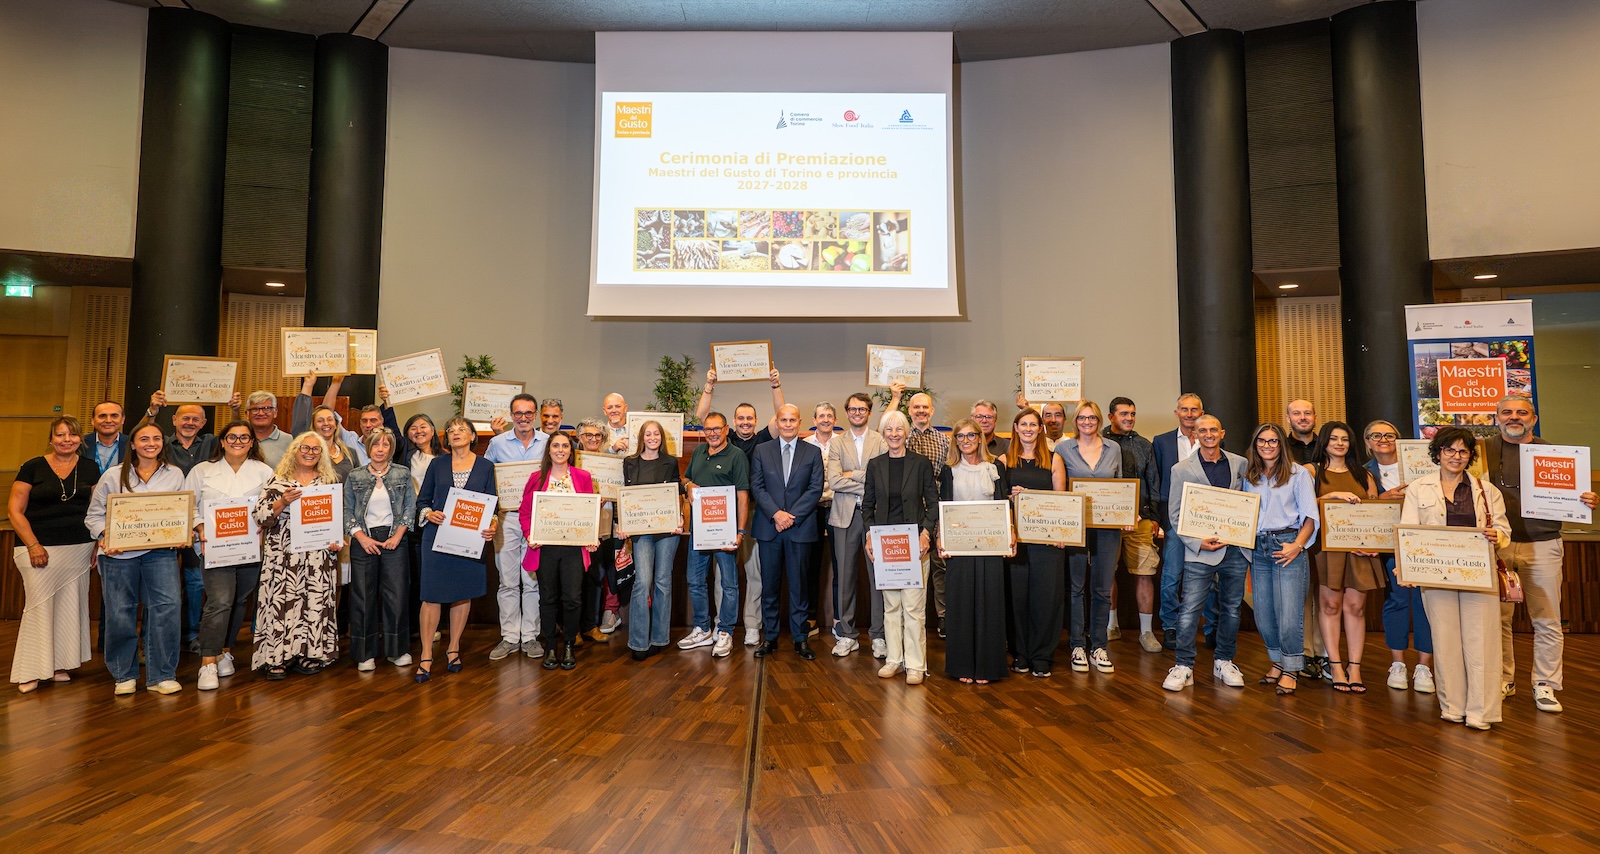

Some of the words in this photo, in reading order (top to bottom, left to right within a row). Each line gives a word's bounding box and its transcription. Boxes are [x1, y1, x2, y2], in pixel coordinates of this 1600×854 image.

[617, 104, 650, 114] Maestri
[619, 119, 648, 128] Gusto
[660, 152, 748, 164] Cerimonia
[755, 152, 770, 164] di
[777, 152, 886, 166] Premiazione
[648, 168, 695, 177] Maestri
[700, 168, 719, 177] del
[724, 168, 760, 178] Gusto
[765, 168, 776, 177] di
[781, 168, 822, 178] Torino
[838, 169, 897, 180] provincia
[738, 180, 808, 190] 2027-2028
[1442, 363, 1502, 378] Maestri
[1449, 385, 1498, 398] Gusto
[1535, 459, 1574, 468] Maestri
[1539, 471, 1571, 480] Gusto
[302, 496, 331, 506] Maestri
[702, 497, 726, 505] Maestri
[457, 501, 484, 513] Maestri
[216, 508, 247, 518] Maestri
[305, 509, 329, 517] Gusto
[456, 512, 478, 522] Gusto
[219, 521, 245, 530] Gusto
[1022, 516, 1050, 524] Maestro
[1058, 518, 1079, 527] Gusto
[882, 536, 908, 544] Maestri
[1406, 554, 1444, 565] Maestro
[1456, 558, 1486, 568] Gusto
[1409, 566, 1443, 574] 2027-28
